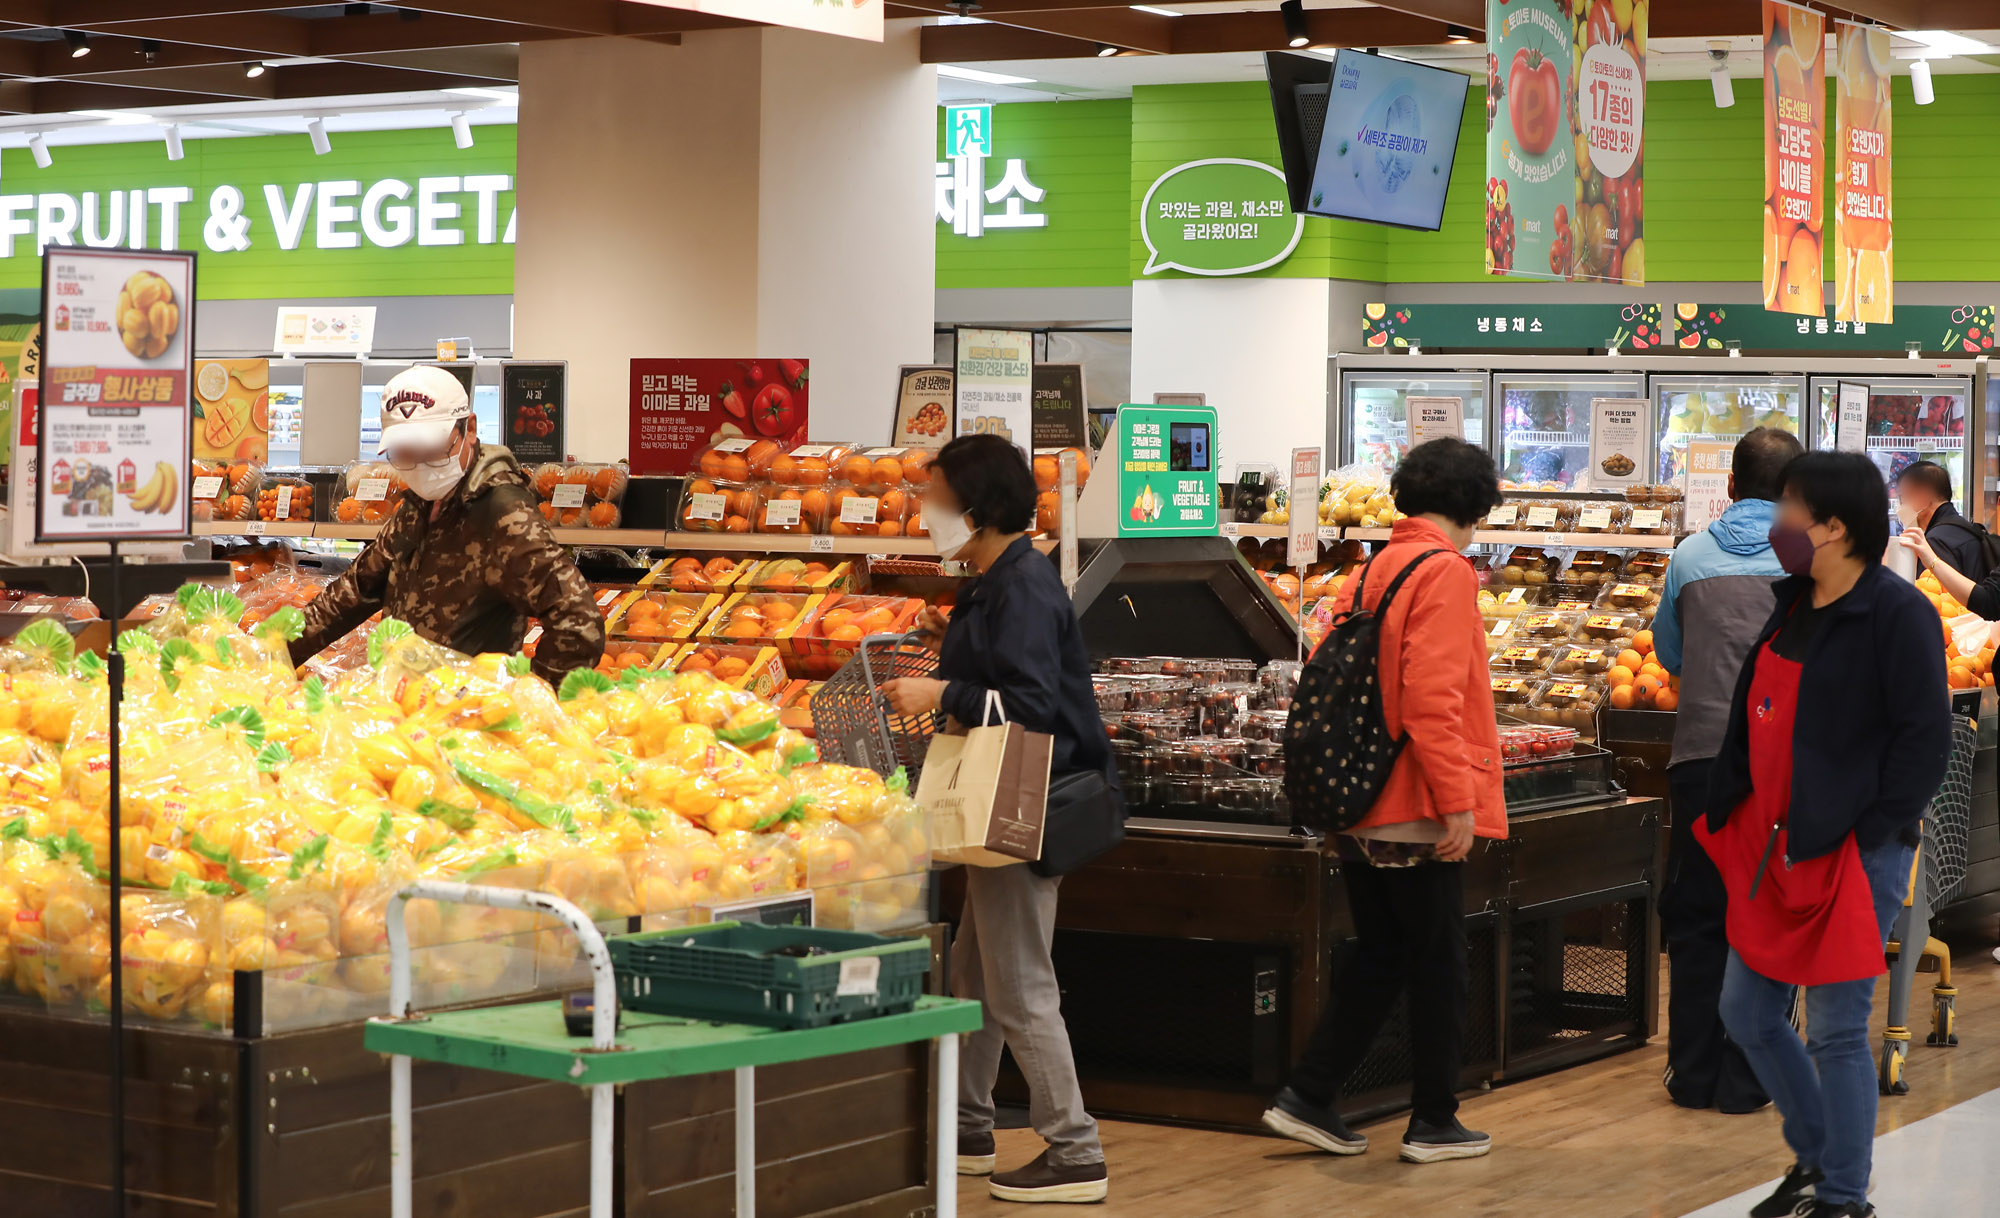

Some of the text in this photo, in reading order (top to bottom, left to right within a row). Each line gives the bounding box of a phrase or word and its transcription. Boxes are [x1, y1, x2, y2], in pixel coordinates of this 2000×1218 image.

[1530, 8, 1567, 49] MUSEUM
[1342, 64, 1360, 81] Downy
[1615, 63, 1633, 80] 신세계!
[1589, 79, 1633, 126] 17종의
[1778, 95, 1812, 123] 당도선별!
[1363, 129, 1428, 155] 세탁조 곰팡이 제거
[1590, 125, 1634, 154] 다양한 맛!
[1778, 123, 1812, 159] 고당도
[1523, 148, 1567, 183] 맛있습니다!
[1778, 158, 1812, 195] 네이블
[1159, 199, 1284, 220] 맛있는 과일, 채소만
[1846, 191, 1884, 220] 맛있습니다
[0, 174, 516, 258] FRUIT & VEGET
[1183, 223, 1258, 241] 골라왔어요!
[1522, 218, 1541, 234] emart
[1602, 225, 1618, 241] emart
[1477, 317, 1543, 332] 냉동채소
[62, 383, 101, 402] 금주의
[103, 375, 174, 403] 행사상품
[642, 375, 697, 392] 믿고 먹는
[526, 390, 543, 400] 사과
[642, 394, 710, 412] 이마트 과일
[1042, 400, 1072, 409] 드립니다
[641, 425, 656, 433] 건강한
[668, 425, 678, 433] 키운
[641, 441, 688, 450] 안심 먹거리가 됩니다
[1178, 480, 1204, 493] FRUIT &
[1172, 493, 1210, 506] VEGETABLE
[1296, 532, 1315, 553] 5,900
[770, 660, 780, 673] 12
